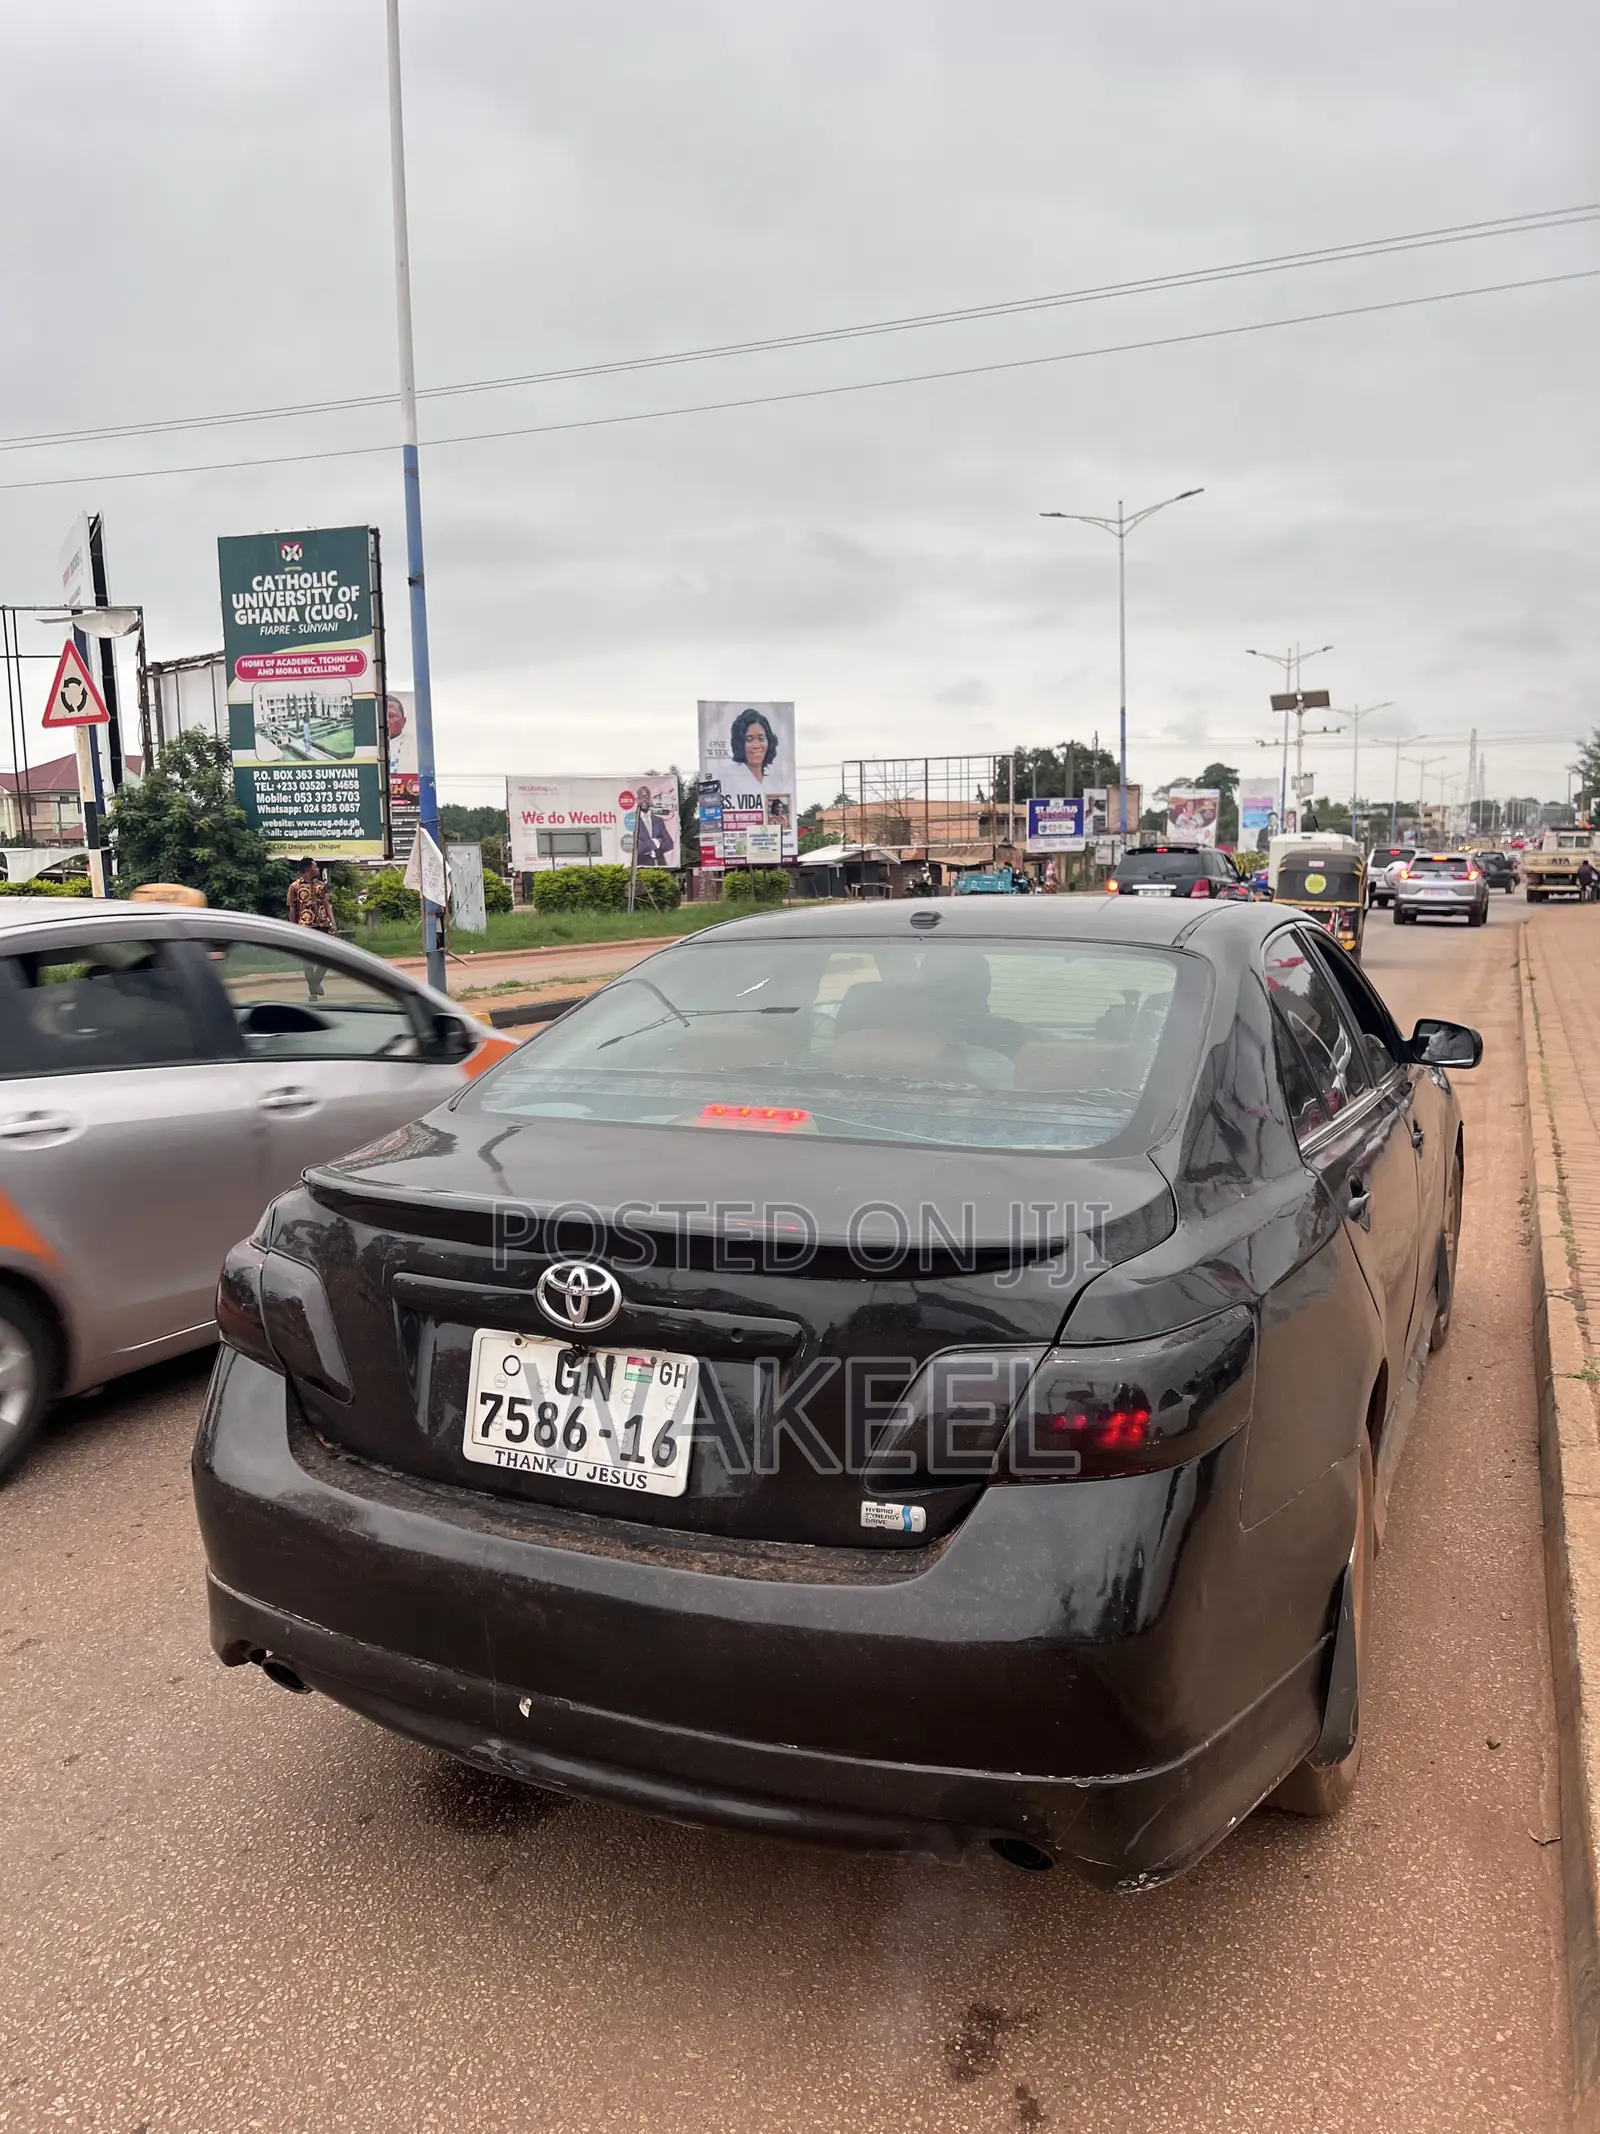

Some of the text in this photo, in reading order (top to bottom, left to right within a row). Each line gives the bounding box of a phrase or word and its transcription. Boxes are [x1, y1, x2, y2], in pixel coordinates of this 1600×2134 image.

[252, 570, 338, 592] CATHOLIC
[232, 585, 360, 609] UNIVERSITY OF
[234, 603, 359, 625] GHANA (CUG),
[260, 625, 291, 636] FIAPRE
[298, 622, 339, 634] SUNYANI
[241, 655, 359, 668] HOME OF ACADEMIC, TECHNICAL
[257, 664, 346, 676] AND MORAL EXCELLENCE
[708, 740, 727, 749] ONE
[253, 768, 358, 781] P.O. BOX 363 SUNYANI
[254, 782, 275, 792] TEL:
[276, 781, 298, 792] +233
[299, 781, 326, 791] 03520
[332, 780, 360, 790] 94658
[256, 791, 361, 804] Mobile: 053 373 5703
[737, 794, 763, 809] VIDA
[257, 803, 361, 816] Whatsapp: 024 926 0857
[261, 818, 360, 828] website: www.cug.edu.gh
[521, 811, 545, 824] We
[548, 811, 565, 824] do
[568, 811, 617, 825] Wealth
[318, 843, 341, 851] Unique
[555, 1347, 689, 1402] GN GH
[495, 1450, 648, 1490] THANK U JESUS
